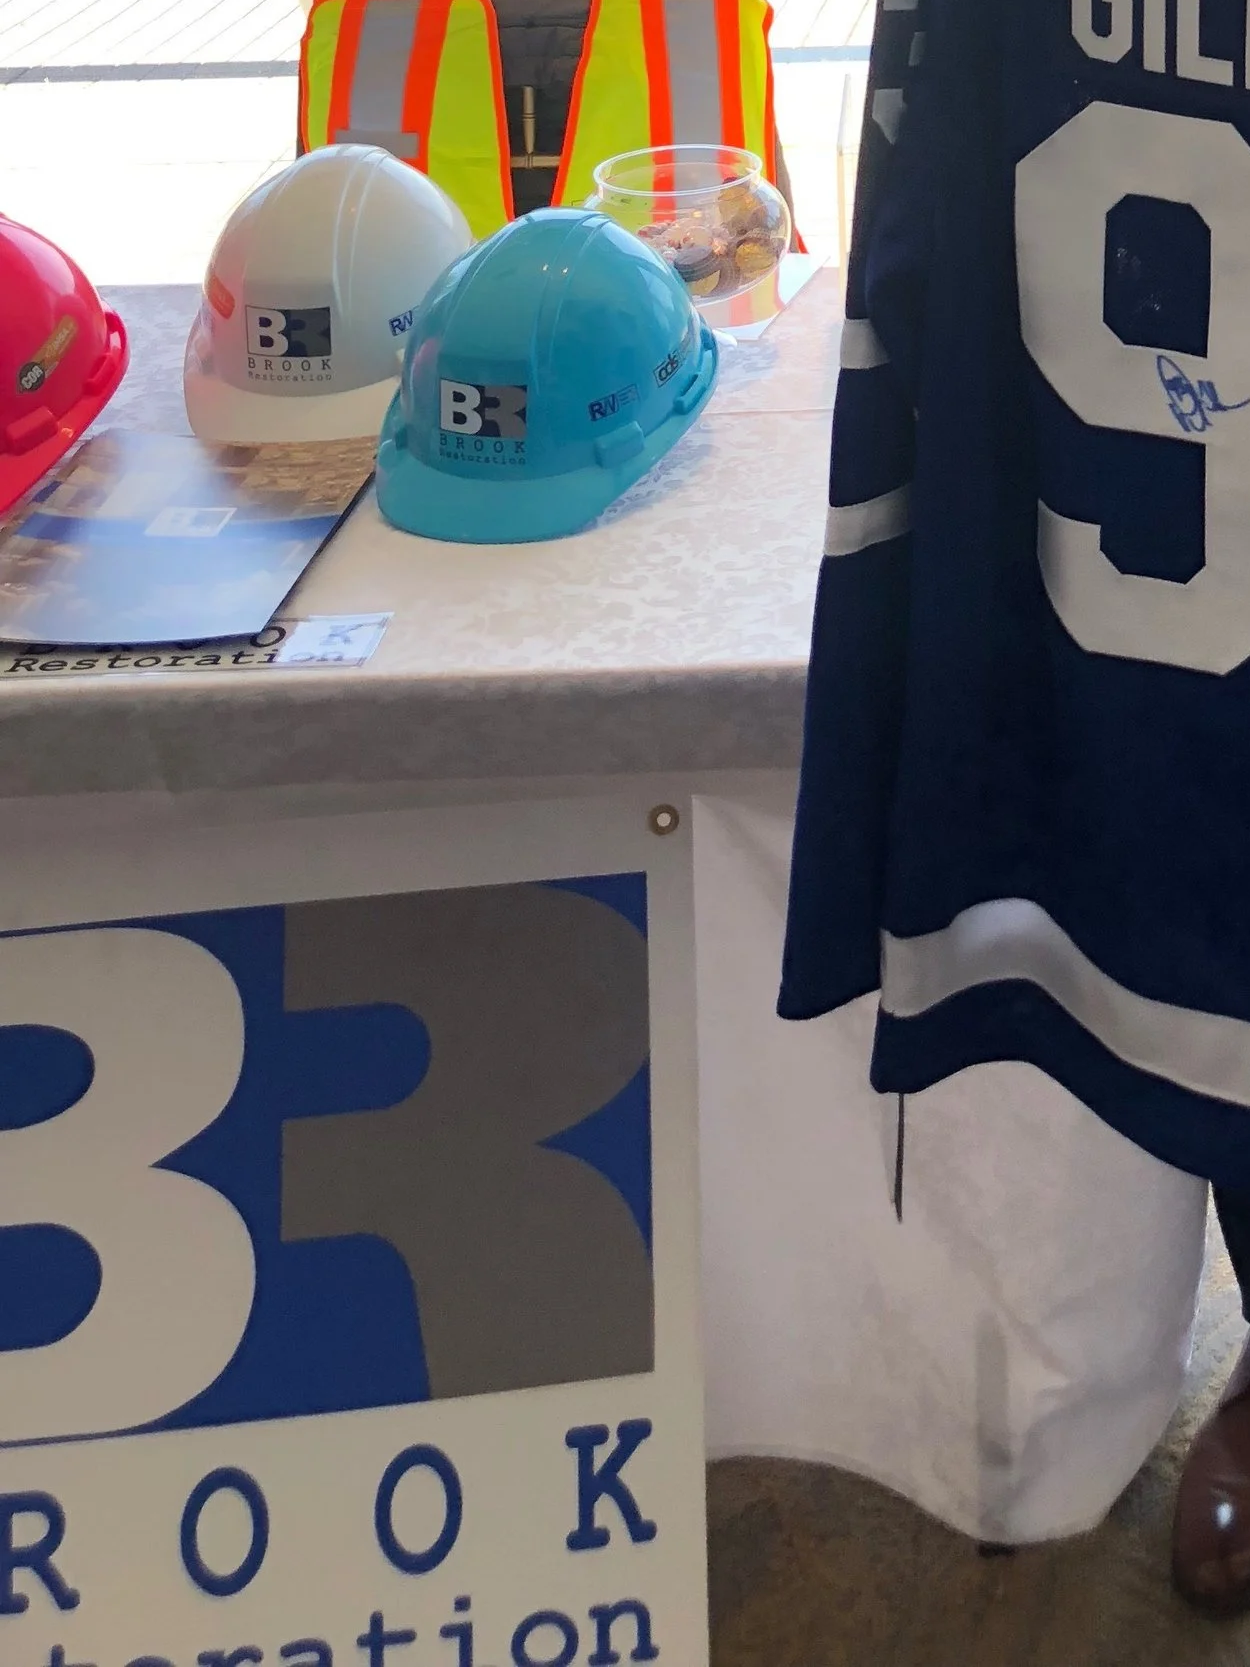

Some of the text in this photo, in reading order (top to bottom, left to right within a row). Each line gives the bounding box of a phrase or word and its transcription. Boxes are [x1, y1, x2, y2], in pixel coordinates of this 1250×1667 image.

[247, 357, 332, 371] BROOK
[247, 371, 332, 382] Restoration
[440, 433, 526, 454] BROOK
[439, 447, 526, 465] Restoration
[0, 1418, 657, 1615] ROOK
